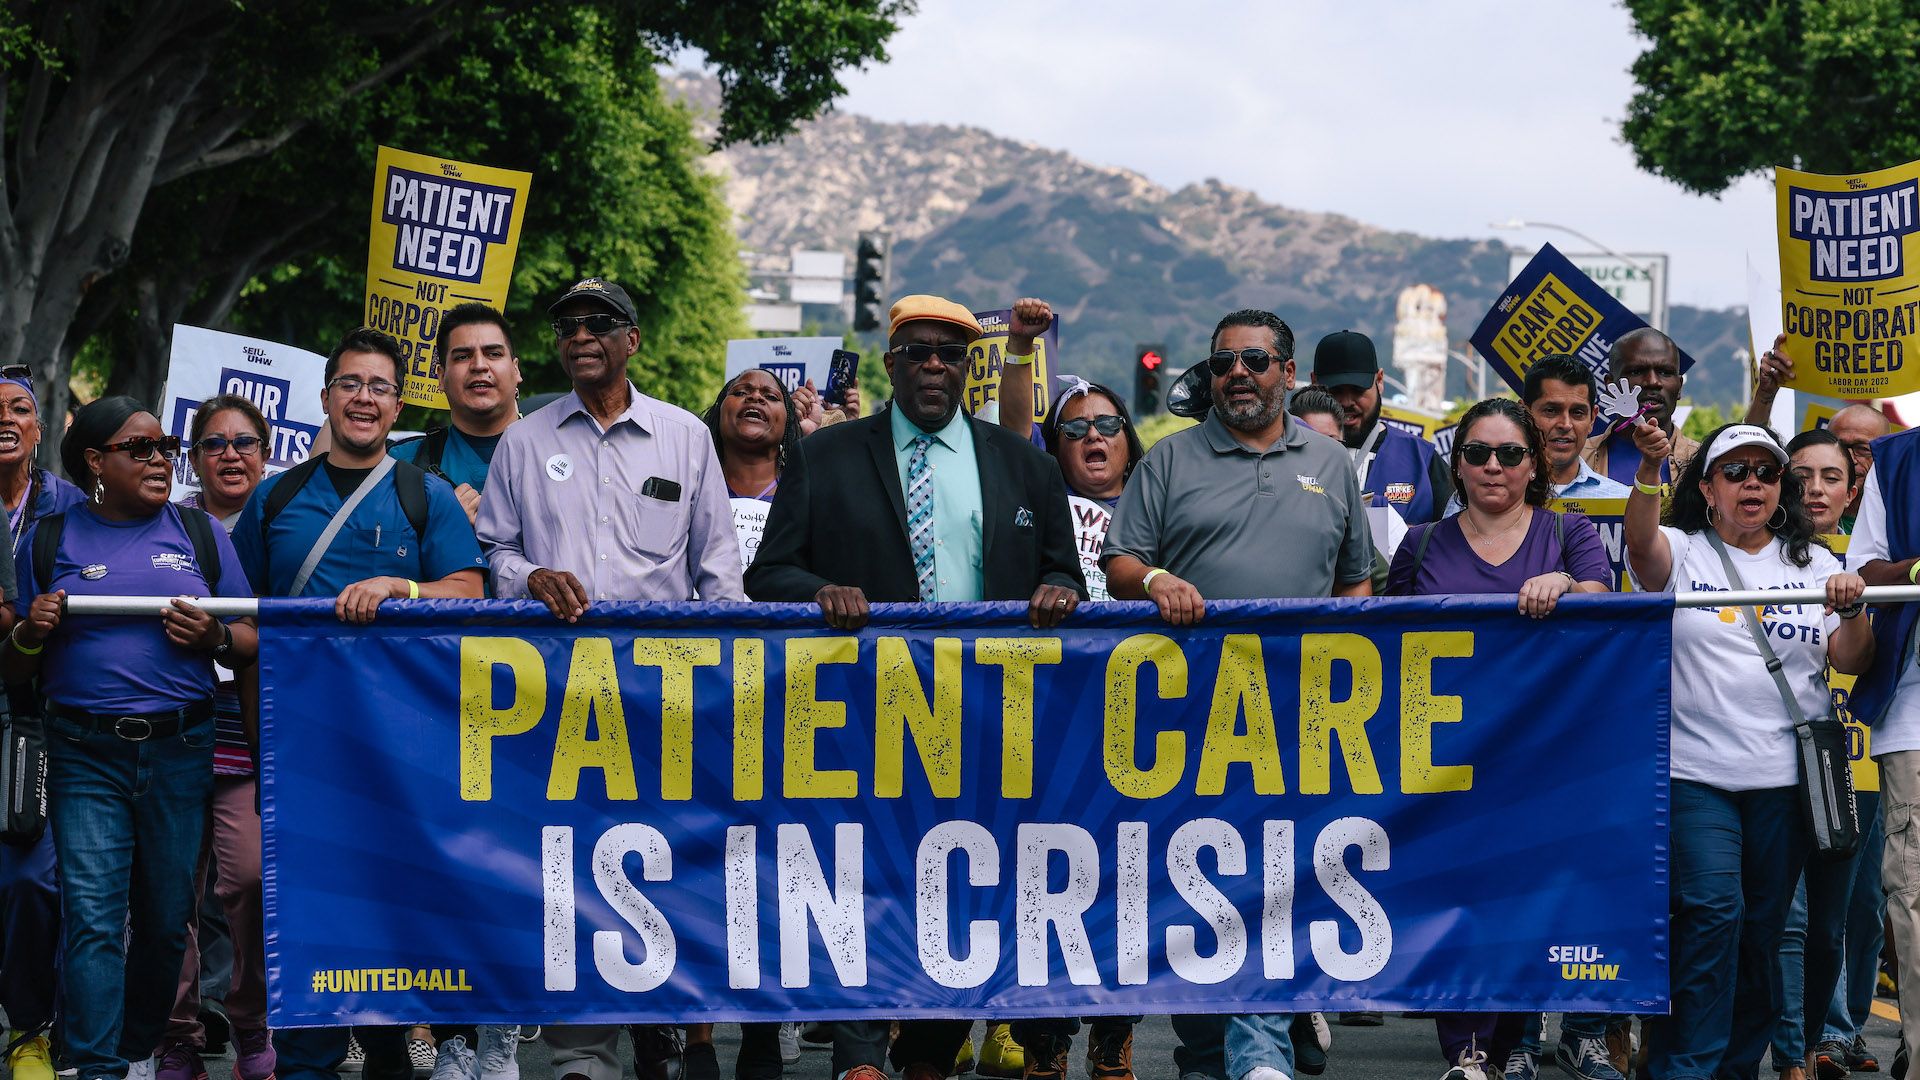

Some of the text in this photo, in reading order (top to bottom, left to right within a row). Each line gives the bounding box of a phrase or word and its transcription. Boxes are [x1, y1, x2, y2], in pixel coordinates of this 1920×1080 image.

[443, 169, 463, 178] UHW
[387, 175, 511, 236] PATIENT
[1794, 186, 1916, 236] PATIENT
[397, 223, 482, 278] NEED
[1816, 235, 1899, 278] NEED
[416, 280, 449, 304] NOT
[1843, 287, 1874, 306] NOT
[368, 293, 449, 341] CORPO
[1508, 280, 1568, 348] CAN'T
[983, 323, 1010, 333] UHW
[243, 346, 267, 357] SEIU-
[247, 355, 273, 366] UHW
[969, 343, 1041, 381] CAT
[1578, 332, 1613, 372] IVE
[1815, 340, 1903, 374] GREED
[411, 381, 425, 391] DAY
[1828, 376, 1889, 387] LABOR DAY 2023
[1386, 485, 1411, 493] STRIKE
[1762, 621, 1820, 646] VOTE
[459, 631, 1475, 801] PATIENT CARE
[541, 816, 1393, 993] IS IN CRISIS
[1548, 946, 1604, 963] SEIU-
[312, 968, 473, 993] #UNITED4ALL
[1562, 964, 1620, 981] UHW
